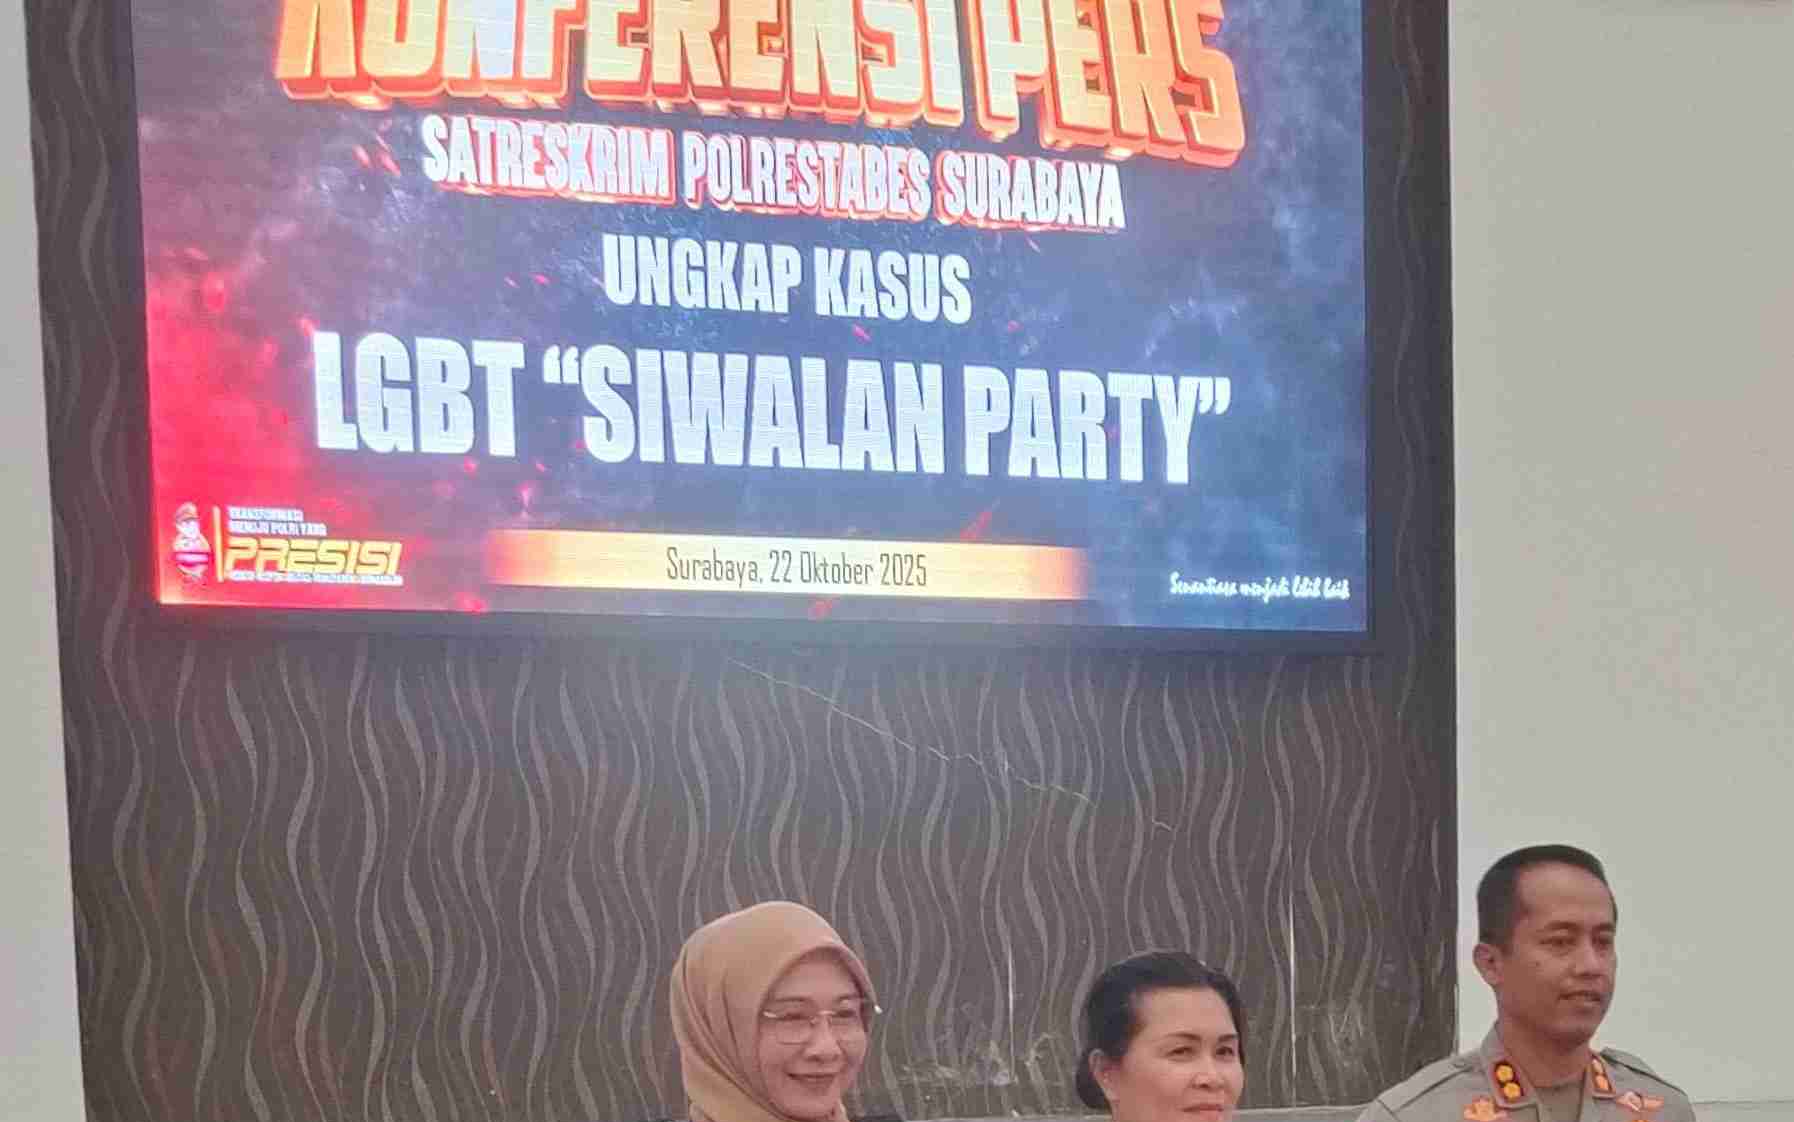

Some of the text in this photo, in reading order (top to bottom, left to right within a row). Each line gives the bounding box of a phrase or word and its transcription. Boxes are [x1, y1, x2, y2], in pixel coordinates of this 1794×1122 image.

[422, 114, 1125, 230] SATRESKRIM POLRESTABES SURABAYA
[602, 233, 972, 324] UNGKAP KASUS
[310, 331, 1231, 485] LGBT “SIWALAN PARTY”
[224, 535, 403, 576] PRESISI
[769, 550, 792, 583] 22
[800, 551, 873, 585] Oktober
[880, 553, 927, 586] 2025
